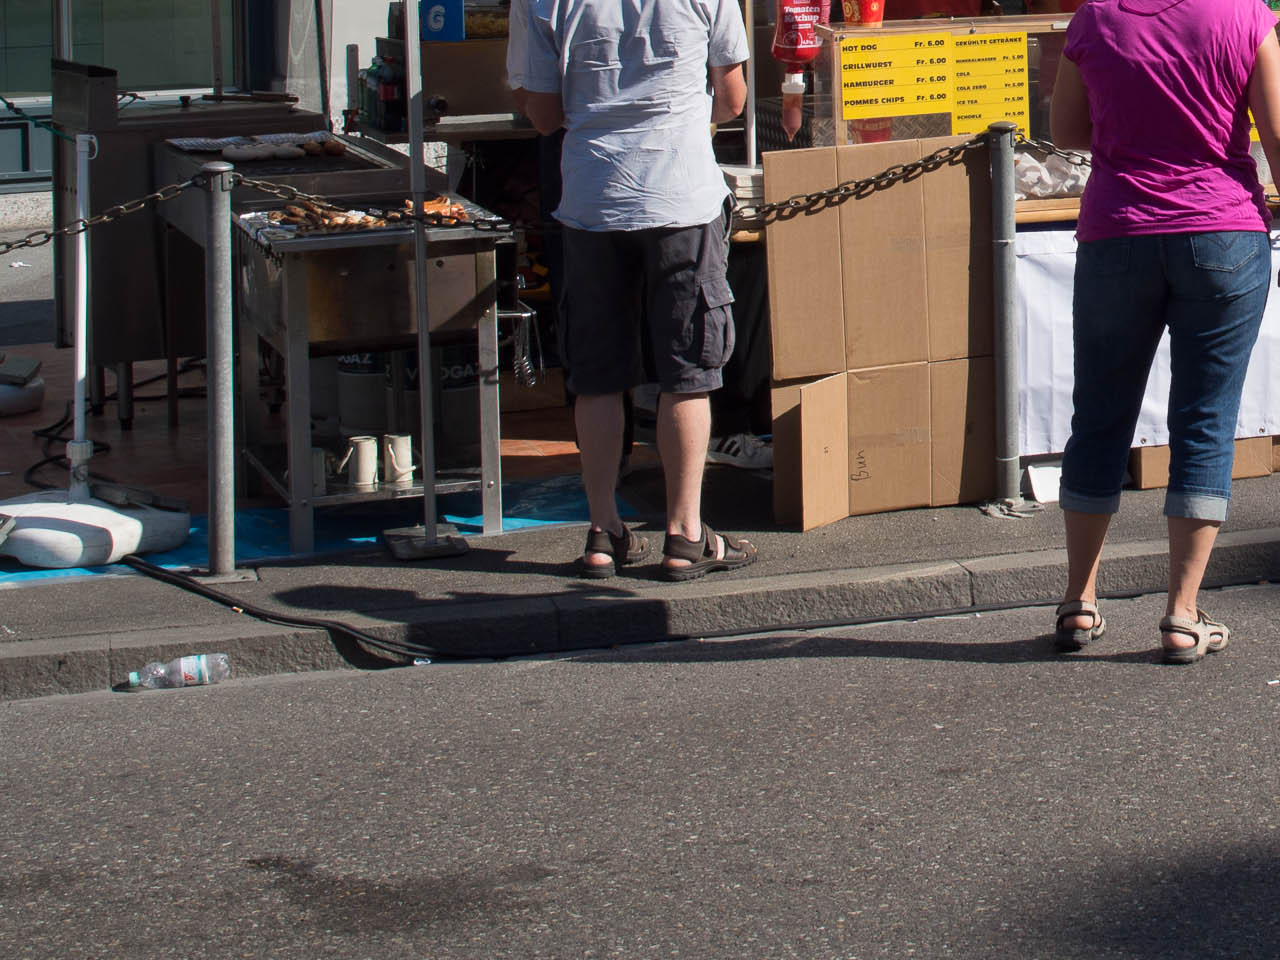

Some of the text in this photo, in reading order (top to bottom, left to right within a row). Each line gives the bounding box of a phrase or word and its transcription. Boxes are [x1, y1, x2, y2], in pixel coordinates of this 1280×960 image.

[784, 6, 820, 14] Tomaten
[843, 62, 892, 70] GRILLWURST
[844, 80, 894, 88] HAMBURGER
